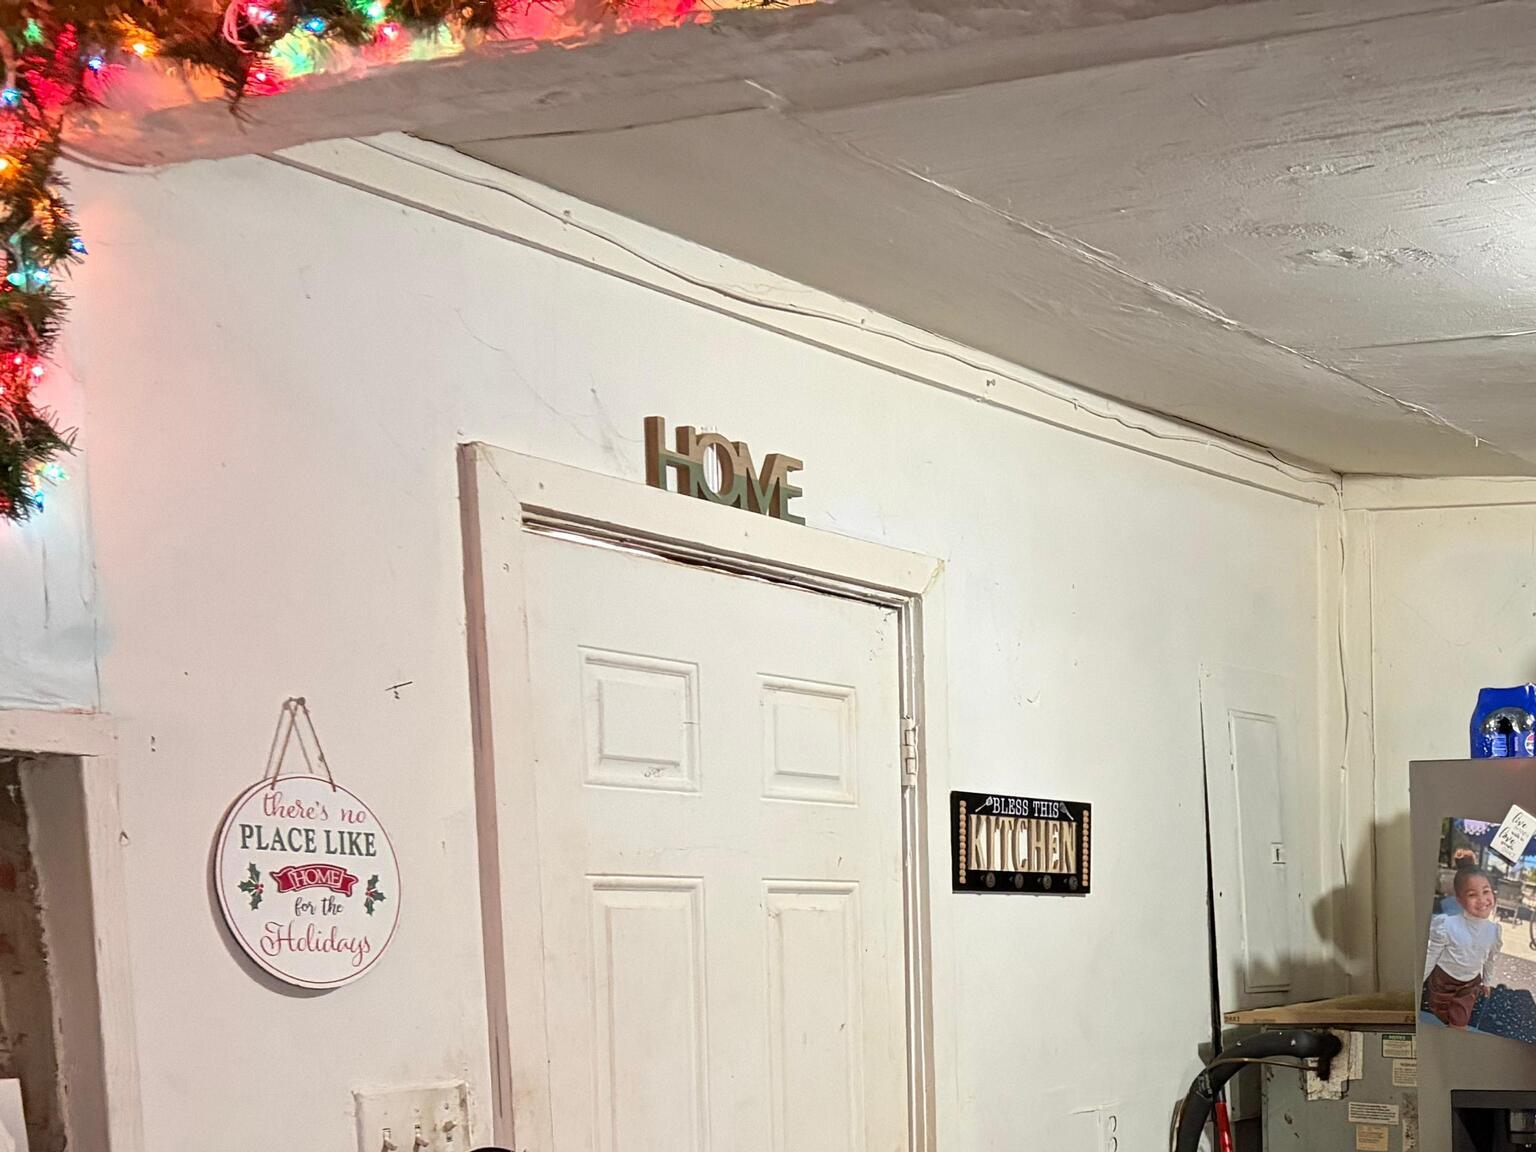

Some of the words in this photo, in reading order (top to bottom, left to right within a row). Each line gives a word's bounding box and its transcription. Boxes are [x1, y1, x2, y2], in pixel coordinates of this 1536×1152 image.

[644, 416, 805, 526] HOME
[263, 791, 329, 821] there's
[340, 807, 367, 824] no
[992, 797, 1029, 816] BLESS
[1032, 799, 1059, 818] THIS
[239, 823, 317, 854] PLACE
[324, 829, 377, 857] LIKE
[968, 814, 1077, 874] KITCHEN
[295, 868, 342, 885] HOME
[295, 896, 315, 917] for
[321, 895, 343, 915] the
[260, 919, 371, 967] Holidays
